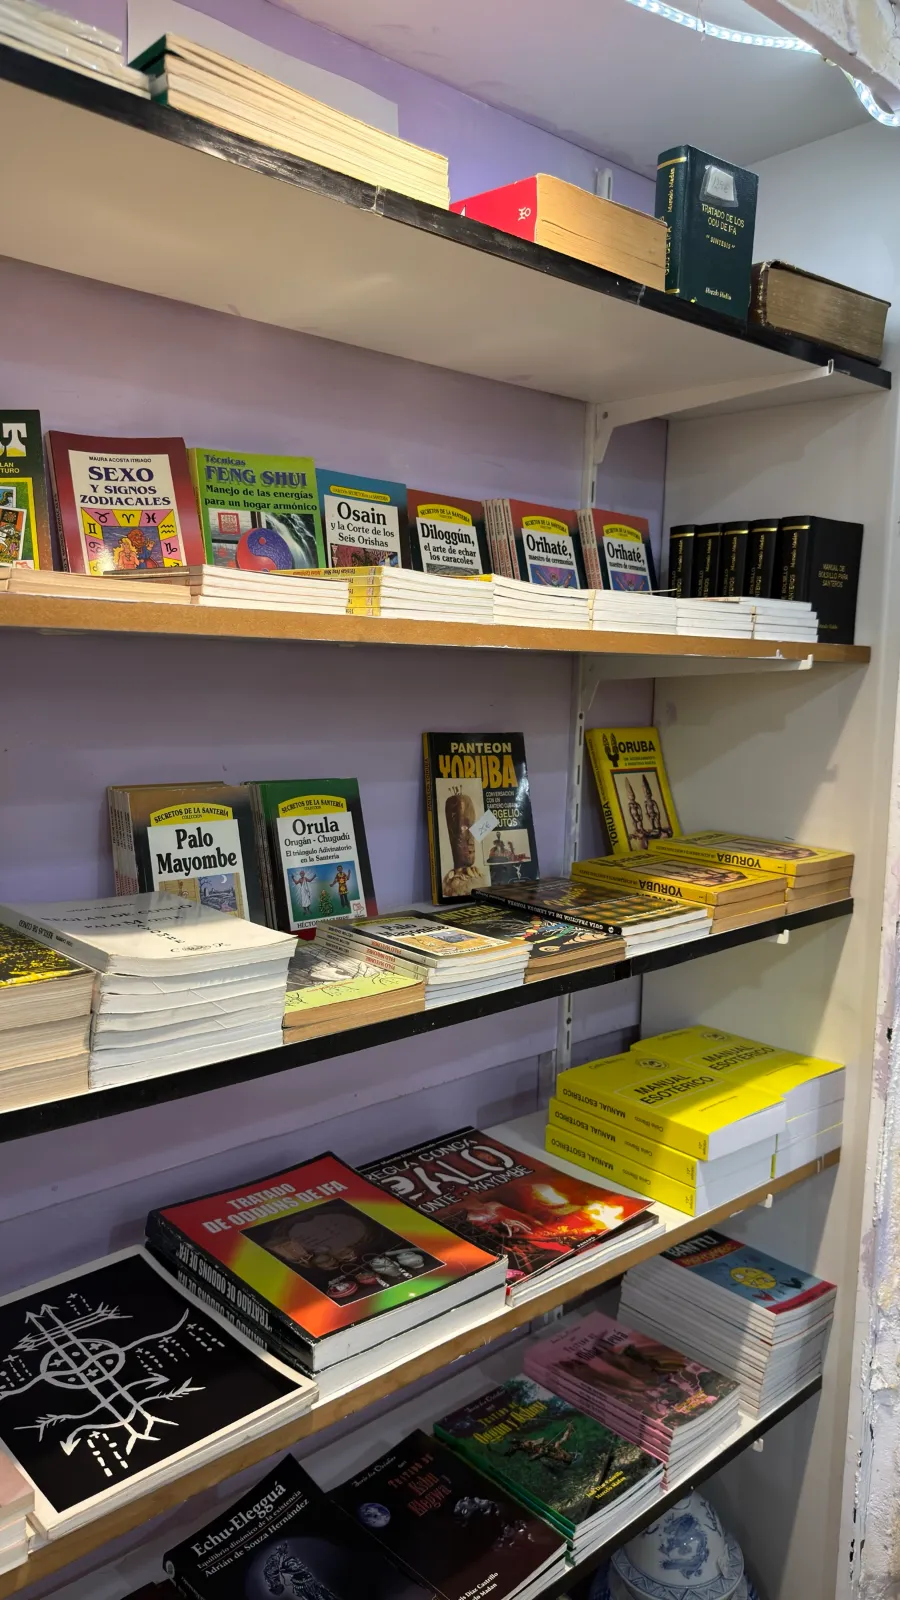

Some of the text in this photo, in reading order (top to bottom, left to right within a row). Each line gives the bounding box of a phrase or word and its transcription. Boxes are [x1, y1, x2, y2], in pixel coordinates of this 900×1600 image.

[701, 203, 745, 228] TRATADO DE LOS
[720, 221, 728, 232] DE
[728, 224, 737, 236] IFA
[204, 454, 246, 466] Técnicas
[88, 466, 154, 482] SEXO
[204, 465, 308, 488] FENG SHUI
[80, 494, 171, 506] ZODIACALES
[90, 484, 157, 495] Y SIGNOS
[206, 485, 314, 500] Manejo de las energías
[204, 498, 318, 511] para un hogar armónico
[337, 501, 387, 526] Osain
[330, 521, 395, 537] y la Corte de los
[338, 532, 389, 547] Seis Orishas
[420, 522, 476, 547] Diloggún,
[423, 542, 477, 557] el arte de echar
[526, 533, 572, 559] Orihaté,
[606, 541, 645, 566] Orihaté,
[429, 551, 474, 565] los caracoles
[451, 742, 512, 754] PANTEON
[438, 754, 518, 789] YORUBA
[154, 806, 229, 824] SECRETOS DE LA SANTERÍA
[281, 801, 305, 813] SECRETOS
[305, 799, 313, 807] DE
[292, 816, 340, 836] Orula
[602, 801, 619, 846] YORUBA
[175, 827, 214, 850] Palo
[284, 832, 350, 848] Orugán Chugudú
[293, 847, 318, 857] triángulo
[318, 844, 353, 855] Adivinatorio
[716, 851, 762, 869] YORUBA
[156, 847, 238, 877] Mayombe
[638, 879, 683, 898] YORUBA
[702, 1044, 756, 1063] MANUAL
[707, 1046, 776, 1071] ESOTÉRICO
[634, 1074, 692, 1095] MANUAL
[640, 1075, 715, 1105] ESOTÉRICO
[562, 1088, 626, 1119] MANUAL ESOTÉRICO
[555, 1111, 616, 1142] MANUAL ESOTÉRICO
[418, 1138, 478, 1163] CONGA
[551, 1138, 614, 1171] MANUAL ESOTÉRICO
[226, 1183, 297, 1210] TRATADO
[417, 1164, 533, 1213] ONTE MAYOMBE
[202, 1180, 349, 1234] DE ODDUNS DE IFA
[189, 1251, 199, 1272] DE
[198, 1258, 227, 1294] ODDUNS
[226, 1281, 237, 1303] DE
[191, 1480, 287, 1558] Echu-Elegguá
[229, 1526, 259, 1549] dinámico
[257, 1518, 267, 1529] de
[264, 1514, 274, 1523] la
[272, 1490, 302, 1517] existencia
[204, 1498, 310, 1578] Adrián de Souza Hernández
